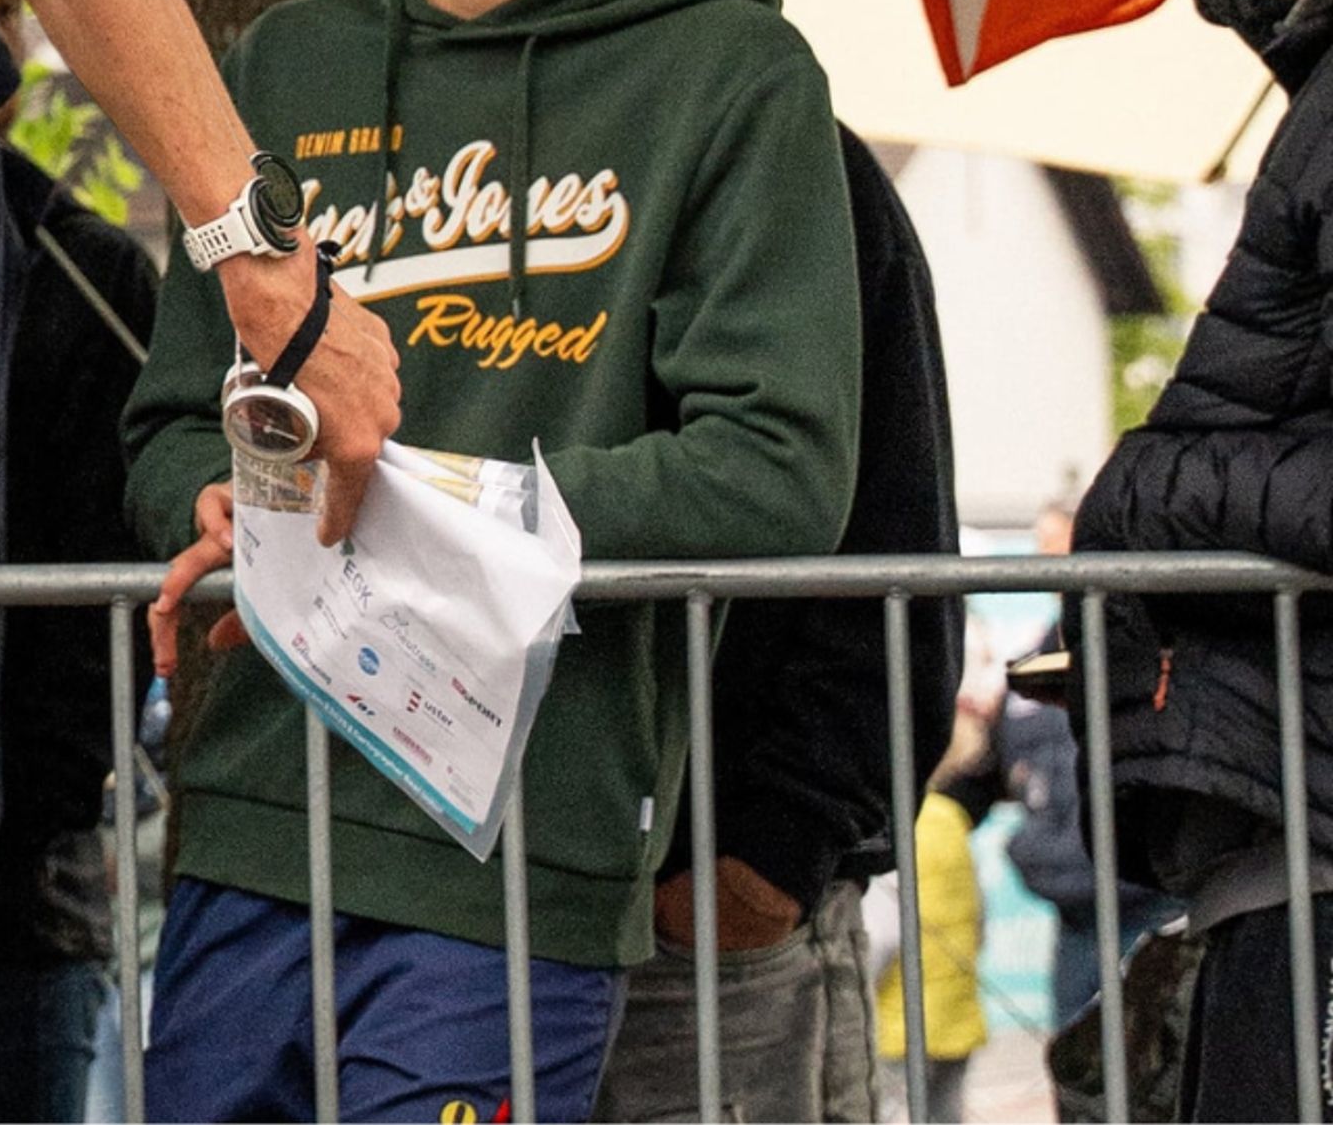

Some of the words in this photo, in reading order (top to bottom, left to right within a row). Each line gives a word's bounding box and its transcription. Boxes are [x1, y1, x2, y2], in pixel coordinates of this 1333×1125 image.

[295, 129, 345, 160] DENIM
[348, 124, 404, 155] BRAD
[407, 294, 608, 369] Rugged
[343, 558, 373, 610] EGK
